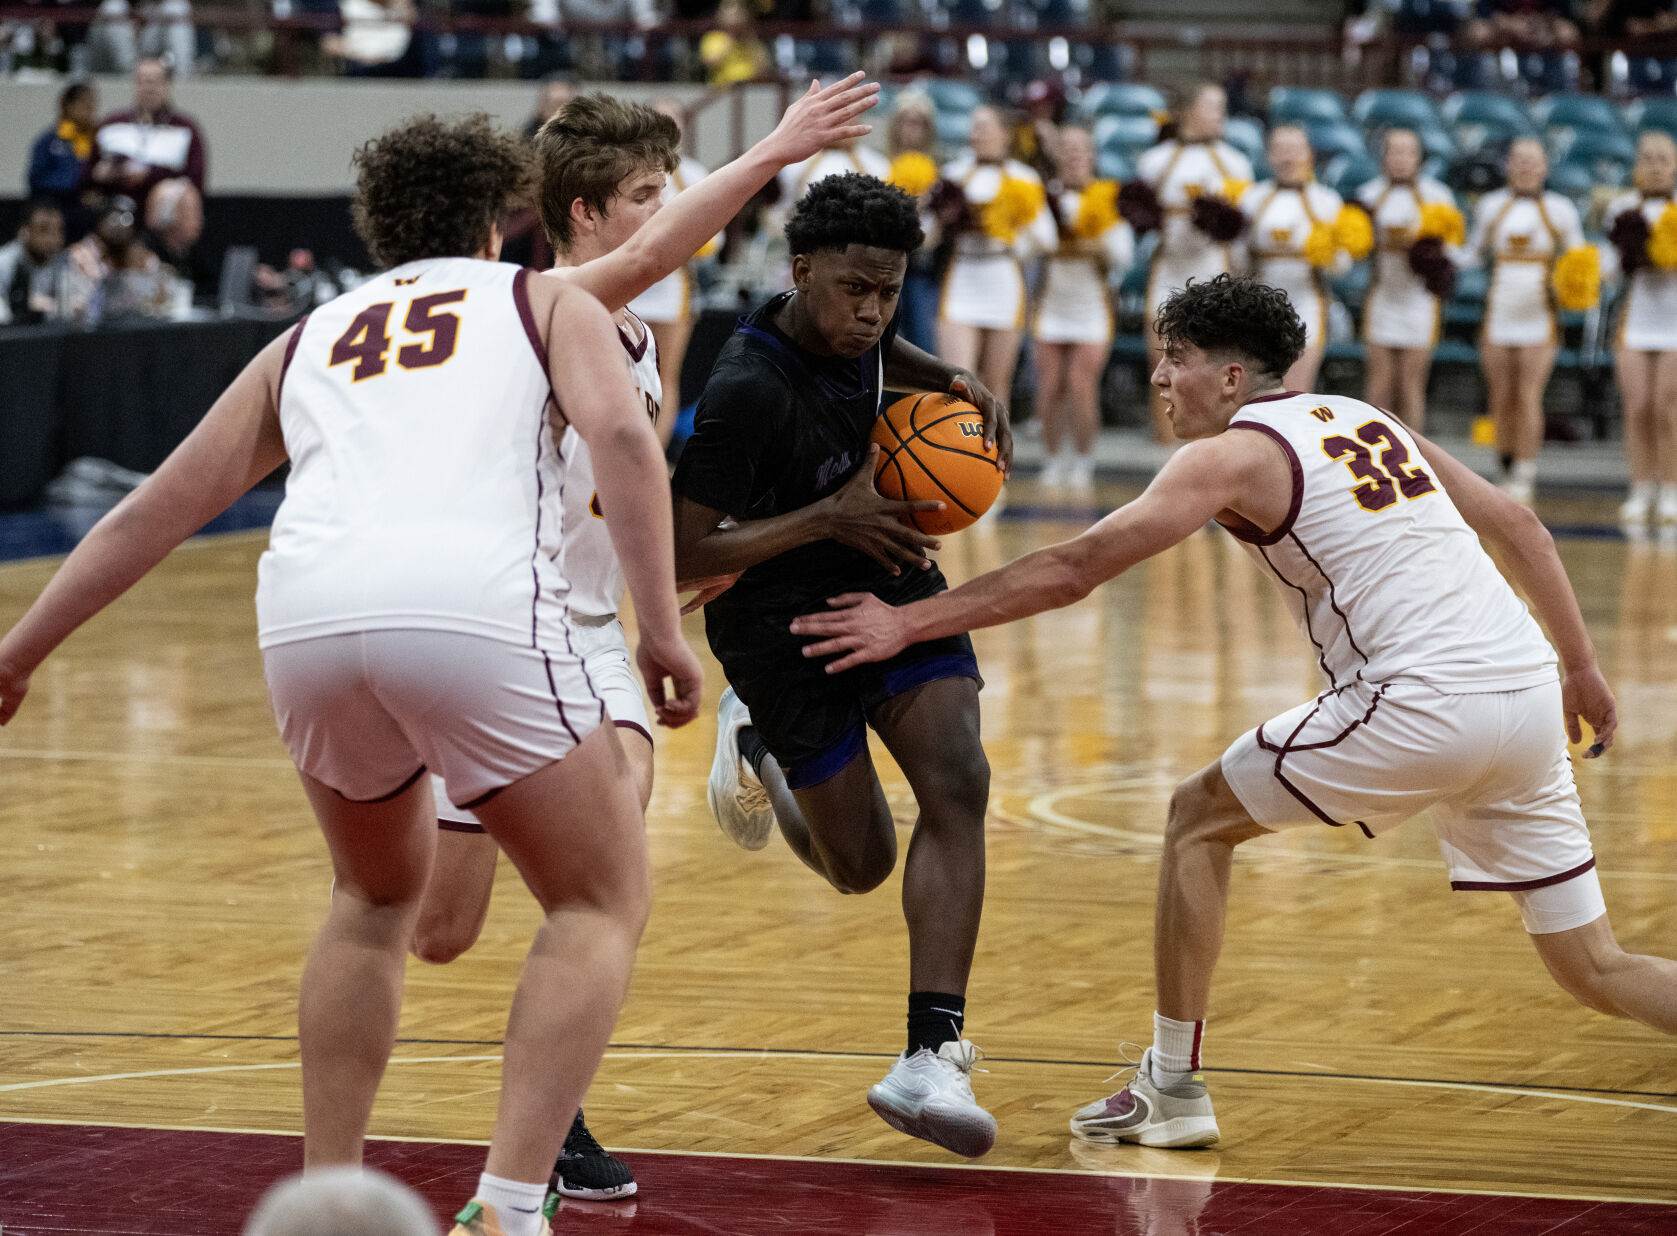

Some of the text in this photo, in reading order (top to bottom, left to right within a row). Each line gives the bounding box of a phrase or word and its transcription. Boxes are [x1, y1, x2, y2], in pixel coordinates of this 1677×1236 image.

[327, 288, 468, 384] 45
[1309, 406, 1335, 423] W
[1321, 420, 1438, 513] 32
